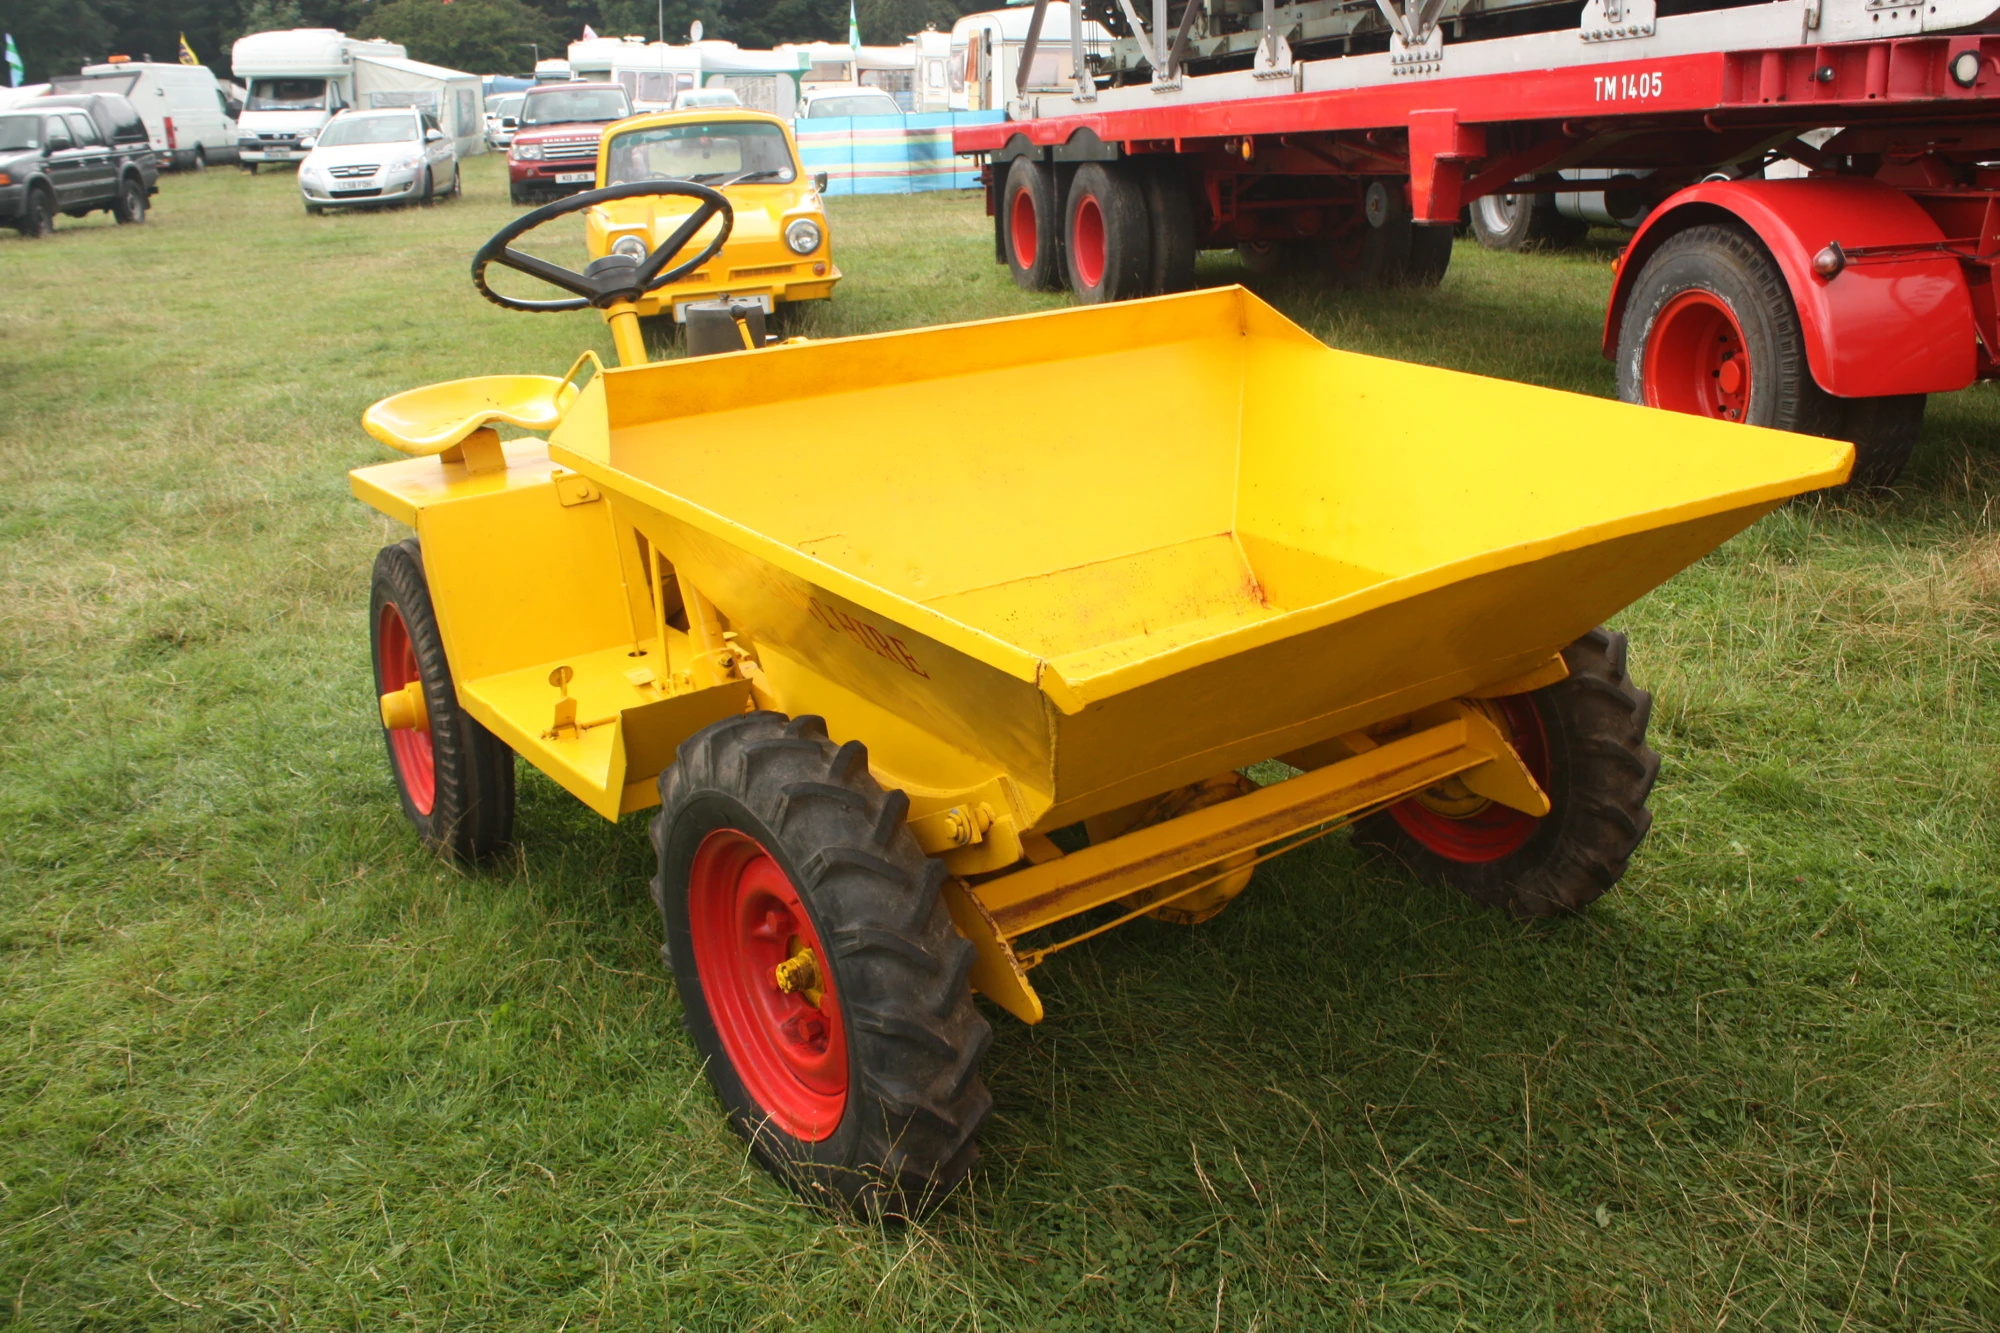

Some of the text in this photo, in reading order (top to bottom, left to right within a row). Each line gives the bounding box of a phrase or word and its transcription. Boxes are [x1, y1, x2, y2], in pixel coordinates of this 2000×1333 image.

[1593, 71, 1663, 102] TM 1405
[824, 604, 931, 680] HIRE
